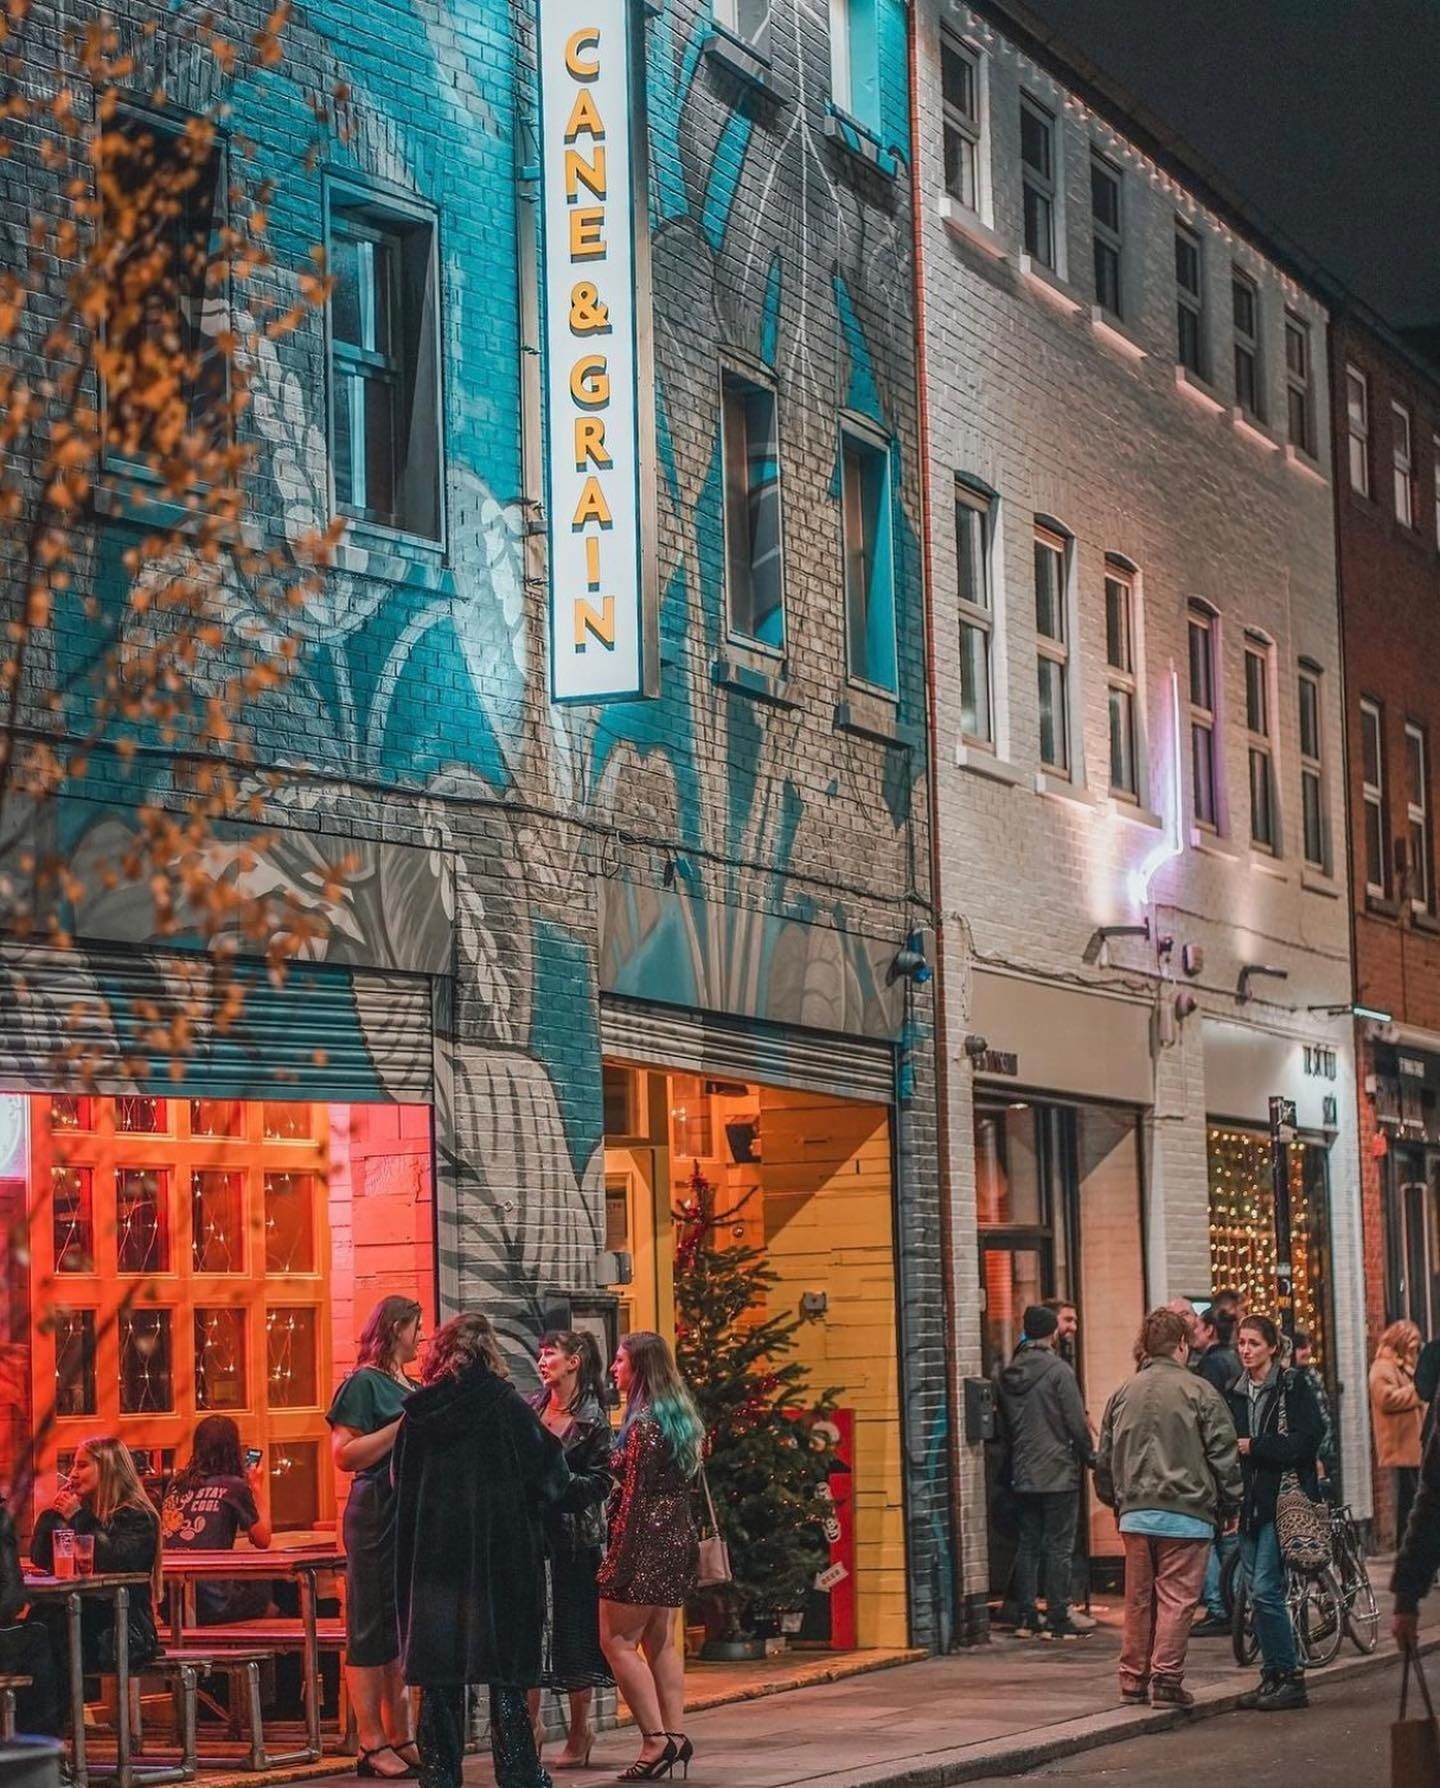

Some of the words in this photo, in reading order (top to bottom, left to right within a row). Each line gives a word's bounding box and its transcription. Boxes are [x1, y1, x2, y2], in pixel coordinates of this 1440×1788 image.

[564, 27, 607, 264] CANE
[569, 281, 612, 336] &
[570, 354, 614, 654] GRAIN
[190, 1500, 220, 1512] COOL
[195, 1487, 228, 1499] STAY
